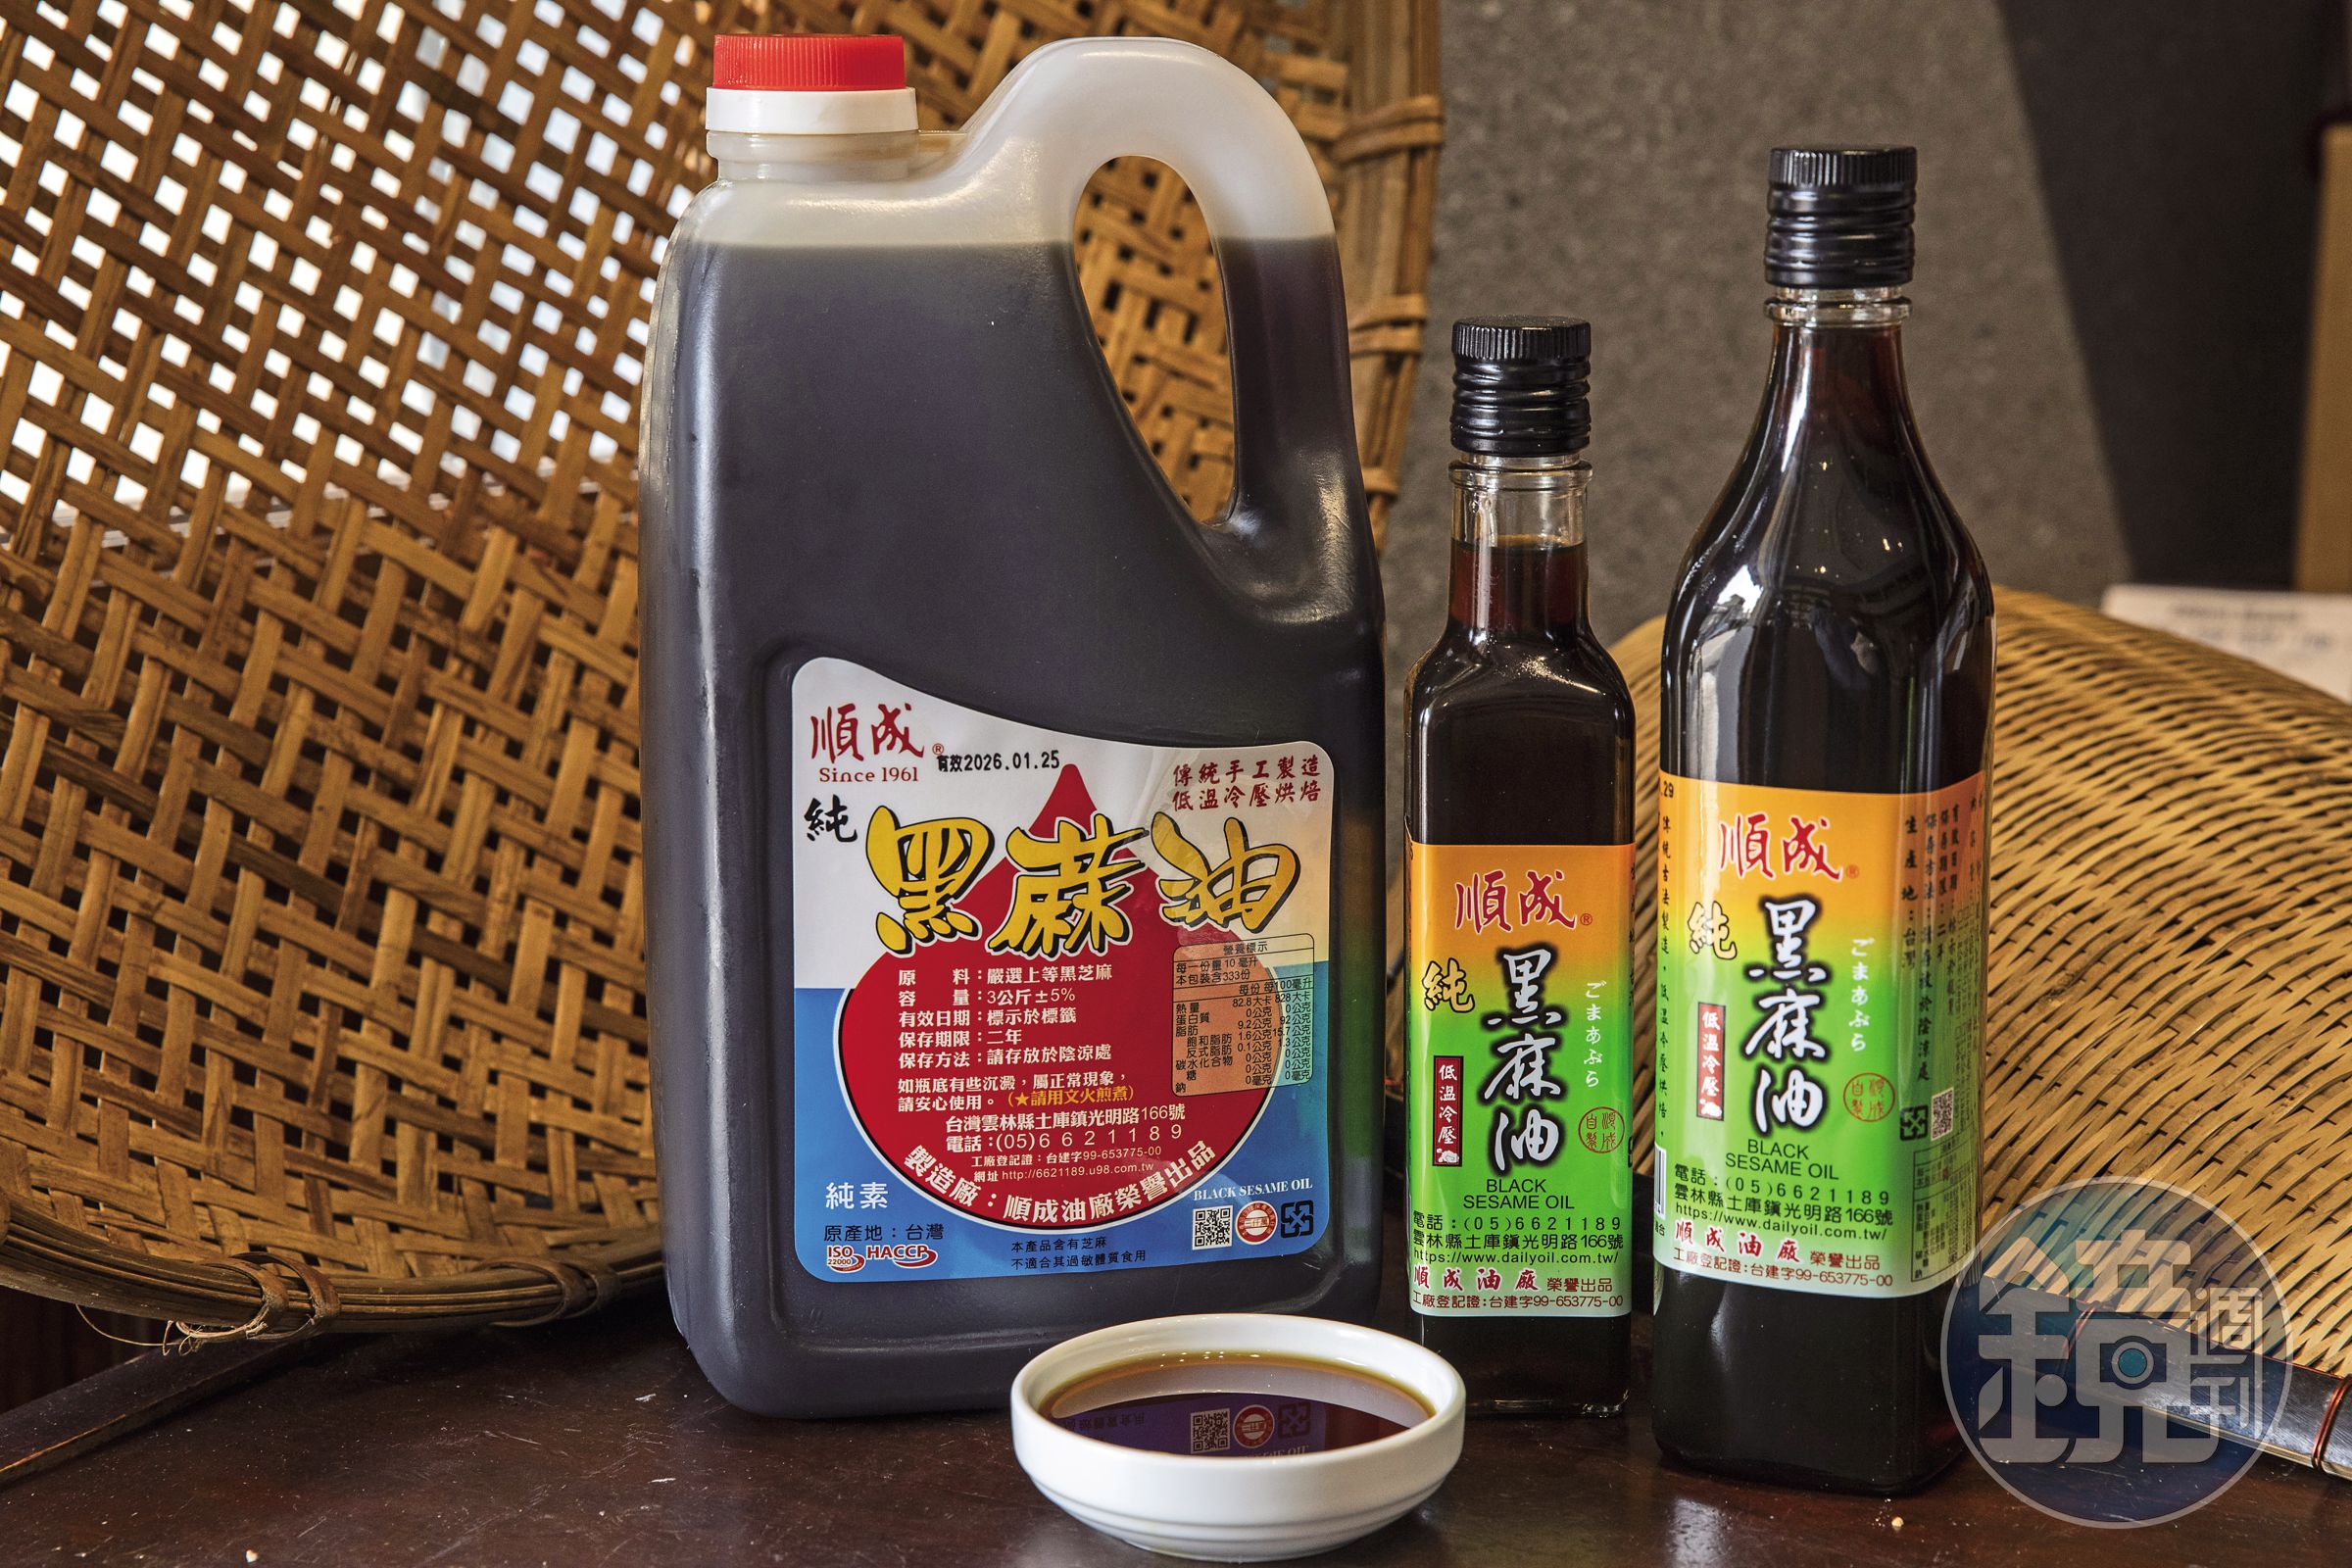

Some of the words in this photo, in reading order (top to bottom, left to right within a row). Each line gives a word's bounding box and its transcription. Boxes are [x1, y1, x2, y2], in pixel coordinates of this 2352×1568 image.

[810, 703, 924, 764] 順成
[819, 767, 875, 783] Since
[882, 767, 918, 782] 1961
[1172, 755, 1321, 786] 傳統手工製造
[1172, 780, 1321, 811] 低溫冷壓烘焙
[804, 794, 858, 843] 純
[1720, 813, 1842, 880] 順成
[1455, 869, 1577, 934] 順成
[1688, 901, 1737, 960] 純
[1223, 941, 1268, 955] 營養標示
[1239, 983, 1260, 996] 每份
[1422, 957, 1475, 1013] 純
[1849, 937, 1875, 1052] ごまあぶら
[899, 1029, 1022, 1049] 保存期限：二年
[1583, 980, 1607, 1088] ごまあぶら
[1701, 1010, 1720, 1096] 低溫冷壓
[1438, 1063, 1458, 1145] 低溫冷壓
[1747, 1139, 1809, 1159] BLACK
[1726, 1152, 1801, 1176] SESAME
[1808, 1163, 1839, 1180] OIL
[825, 1182, 889, 1209] 純素
[1194, 1186, 1236, 1201] BLACK
[1239, 1181, 1289, 1196] SESAME
[1291, 1178, 1313, 1190] OIL
[1486, 1179, 1546, 1193] BLACK
[1463, 1195, 1540, 1209] SESAME
[1545, 1195, 1575, 1209] OIL
[824, 1223, 944, 1242] 原產地：台灣
[1011, 1236, 1107, 1253] 本產品含有芝麻
[1675, 1220, 1801, 1263] 順成油廠
[1810, 1250, 1881, 1271] 榮譽出品
[827, 1246, 853, 1257] ISO
[866, 1245, 928, 1258] HACCP
[1413, 1265, 1540, 1291] 順成油廠
[1546, 1277, 1613, 1293] 榮譽出品
